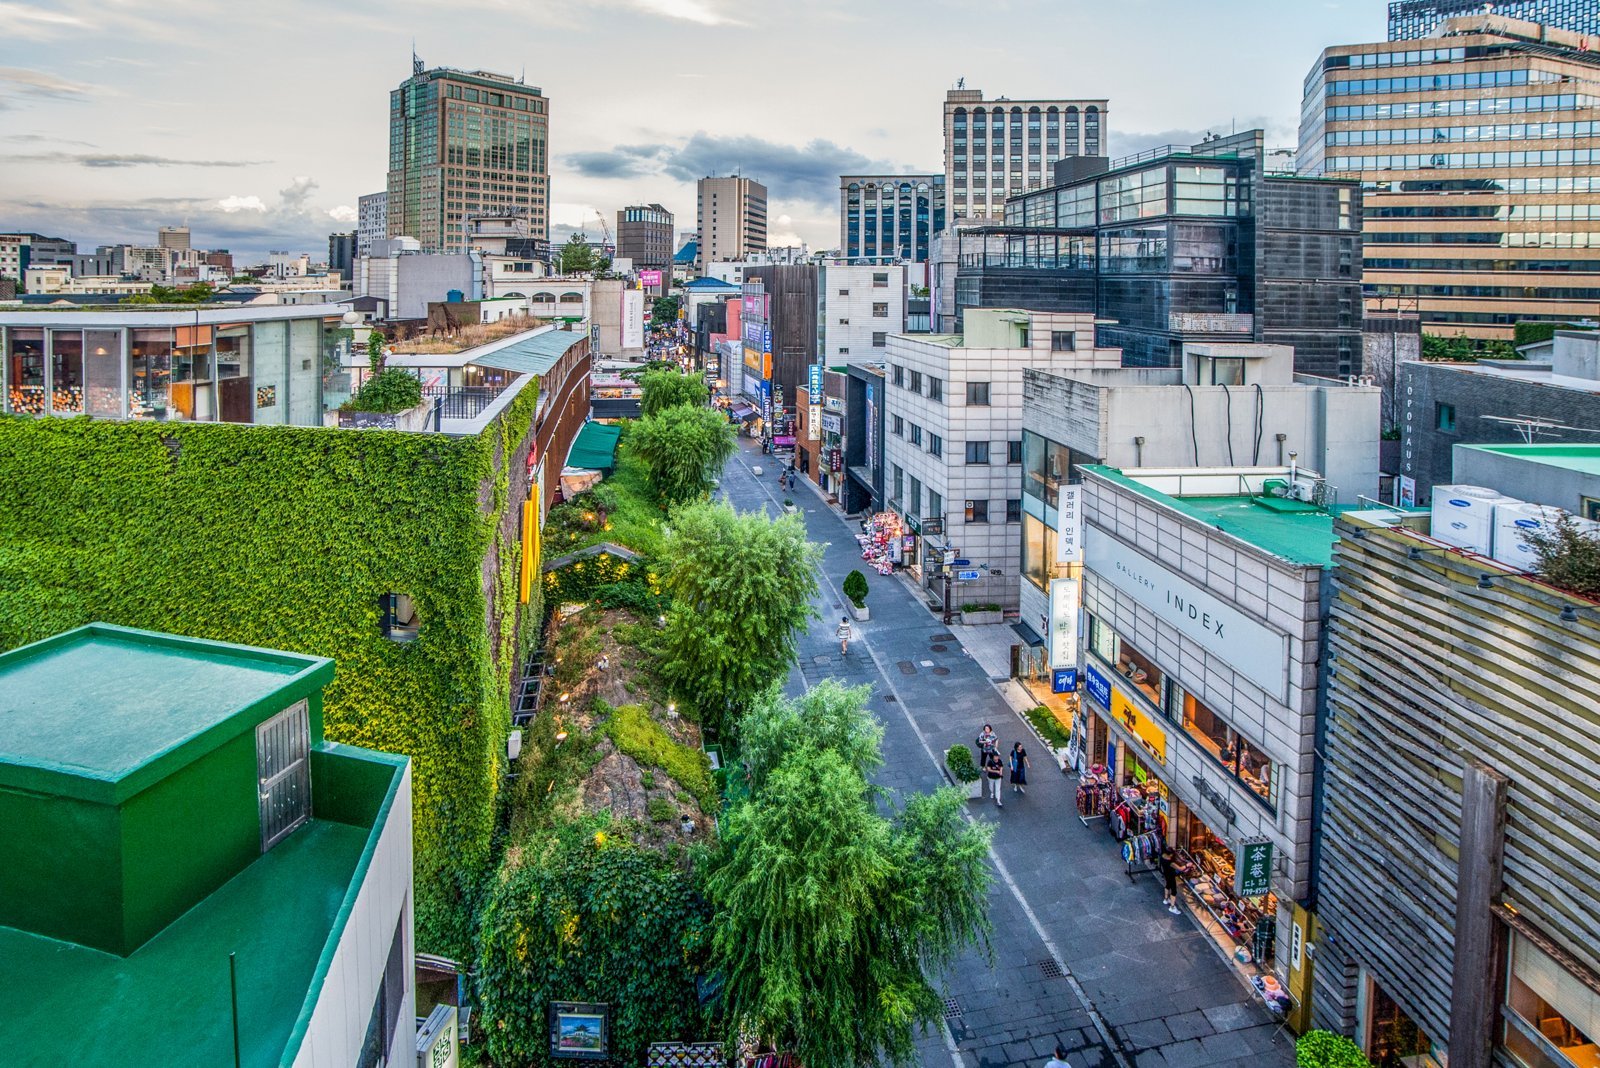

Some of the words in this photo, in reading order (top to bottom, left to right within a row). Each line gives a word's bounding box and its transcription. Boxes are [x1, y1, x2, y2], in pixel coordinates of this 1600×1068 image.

[1066, 490, 1075, 520] 갤러리
[1064, 527, 1075, 556] 인덱스
[1116, 561, 1156, 592] GALLERY
[1166, 590, 1226, 638] INDEX
